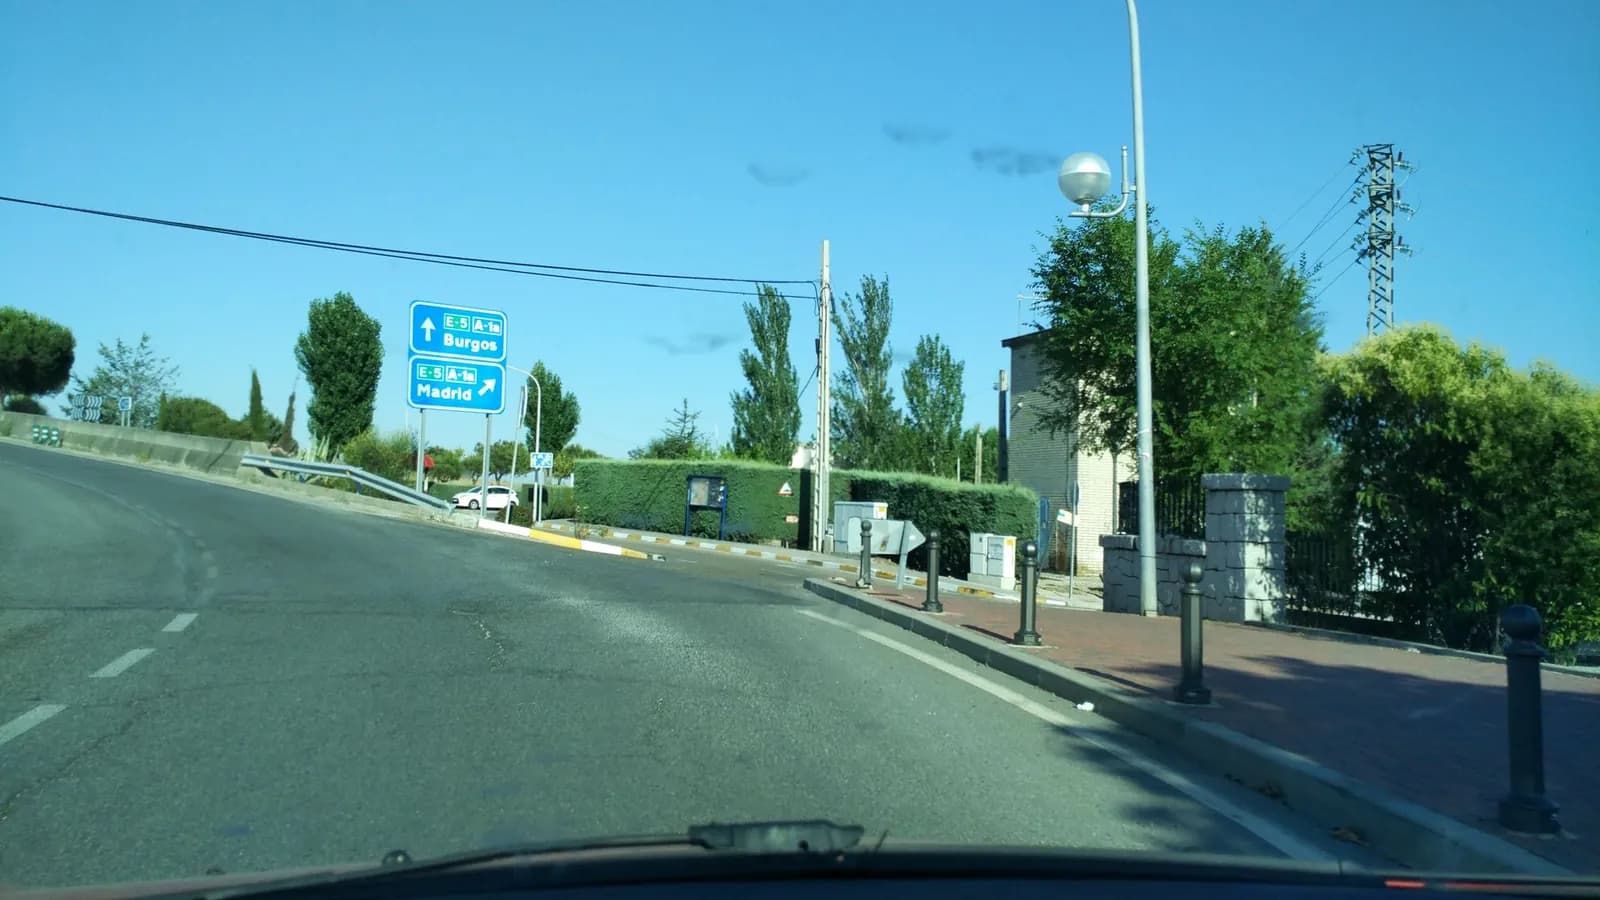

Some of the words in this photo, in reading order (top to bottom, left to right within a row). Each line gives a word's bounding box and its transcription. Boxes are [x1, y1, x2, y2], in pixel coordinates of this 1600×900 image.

[445, 315, 468, 330] E-5
[443, 333, 498, 352] Burgos
[419, 366, 442, 379] E-5
[417, 383, 472, 401] Madrid
